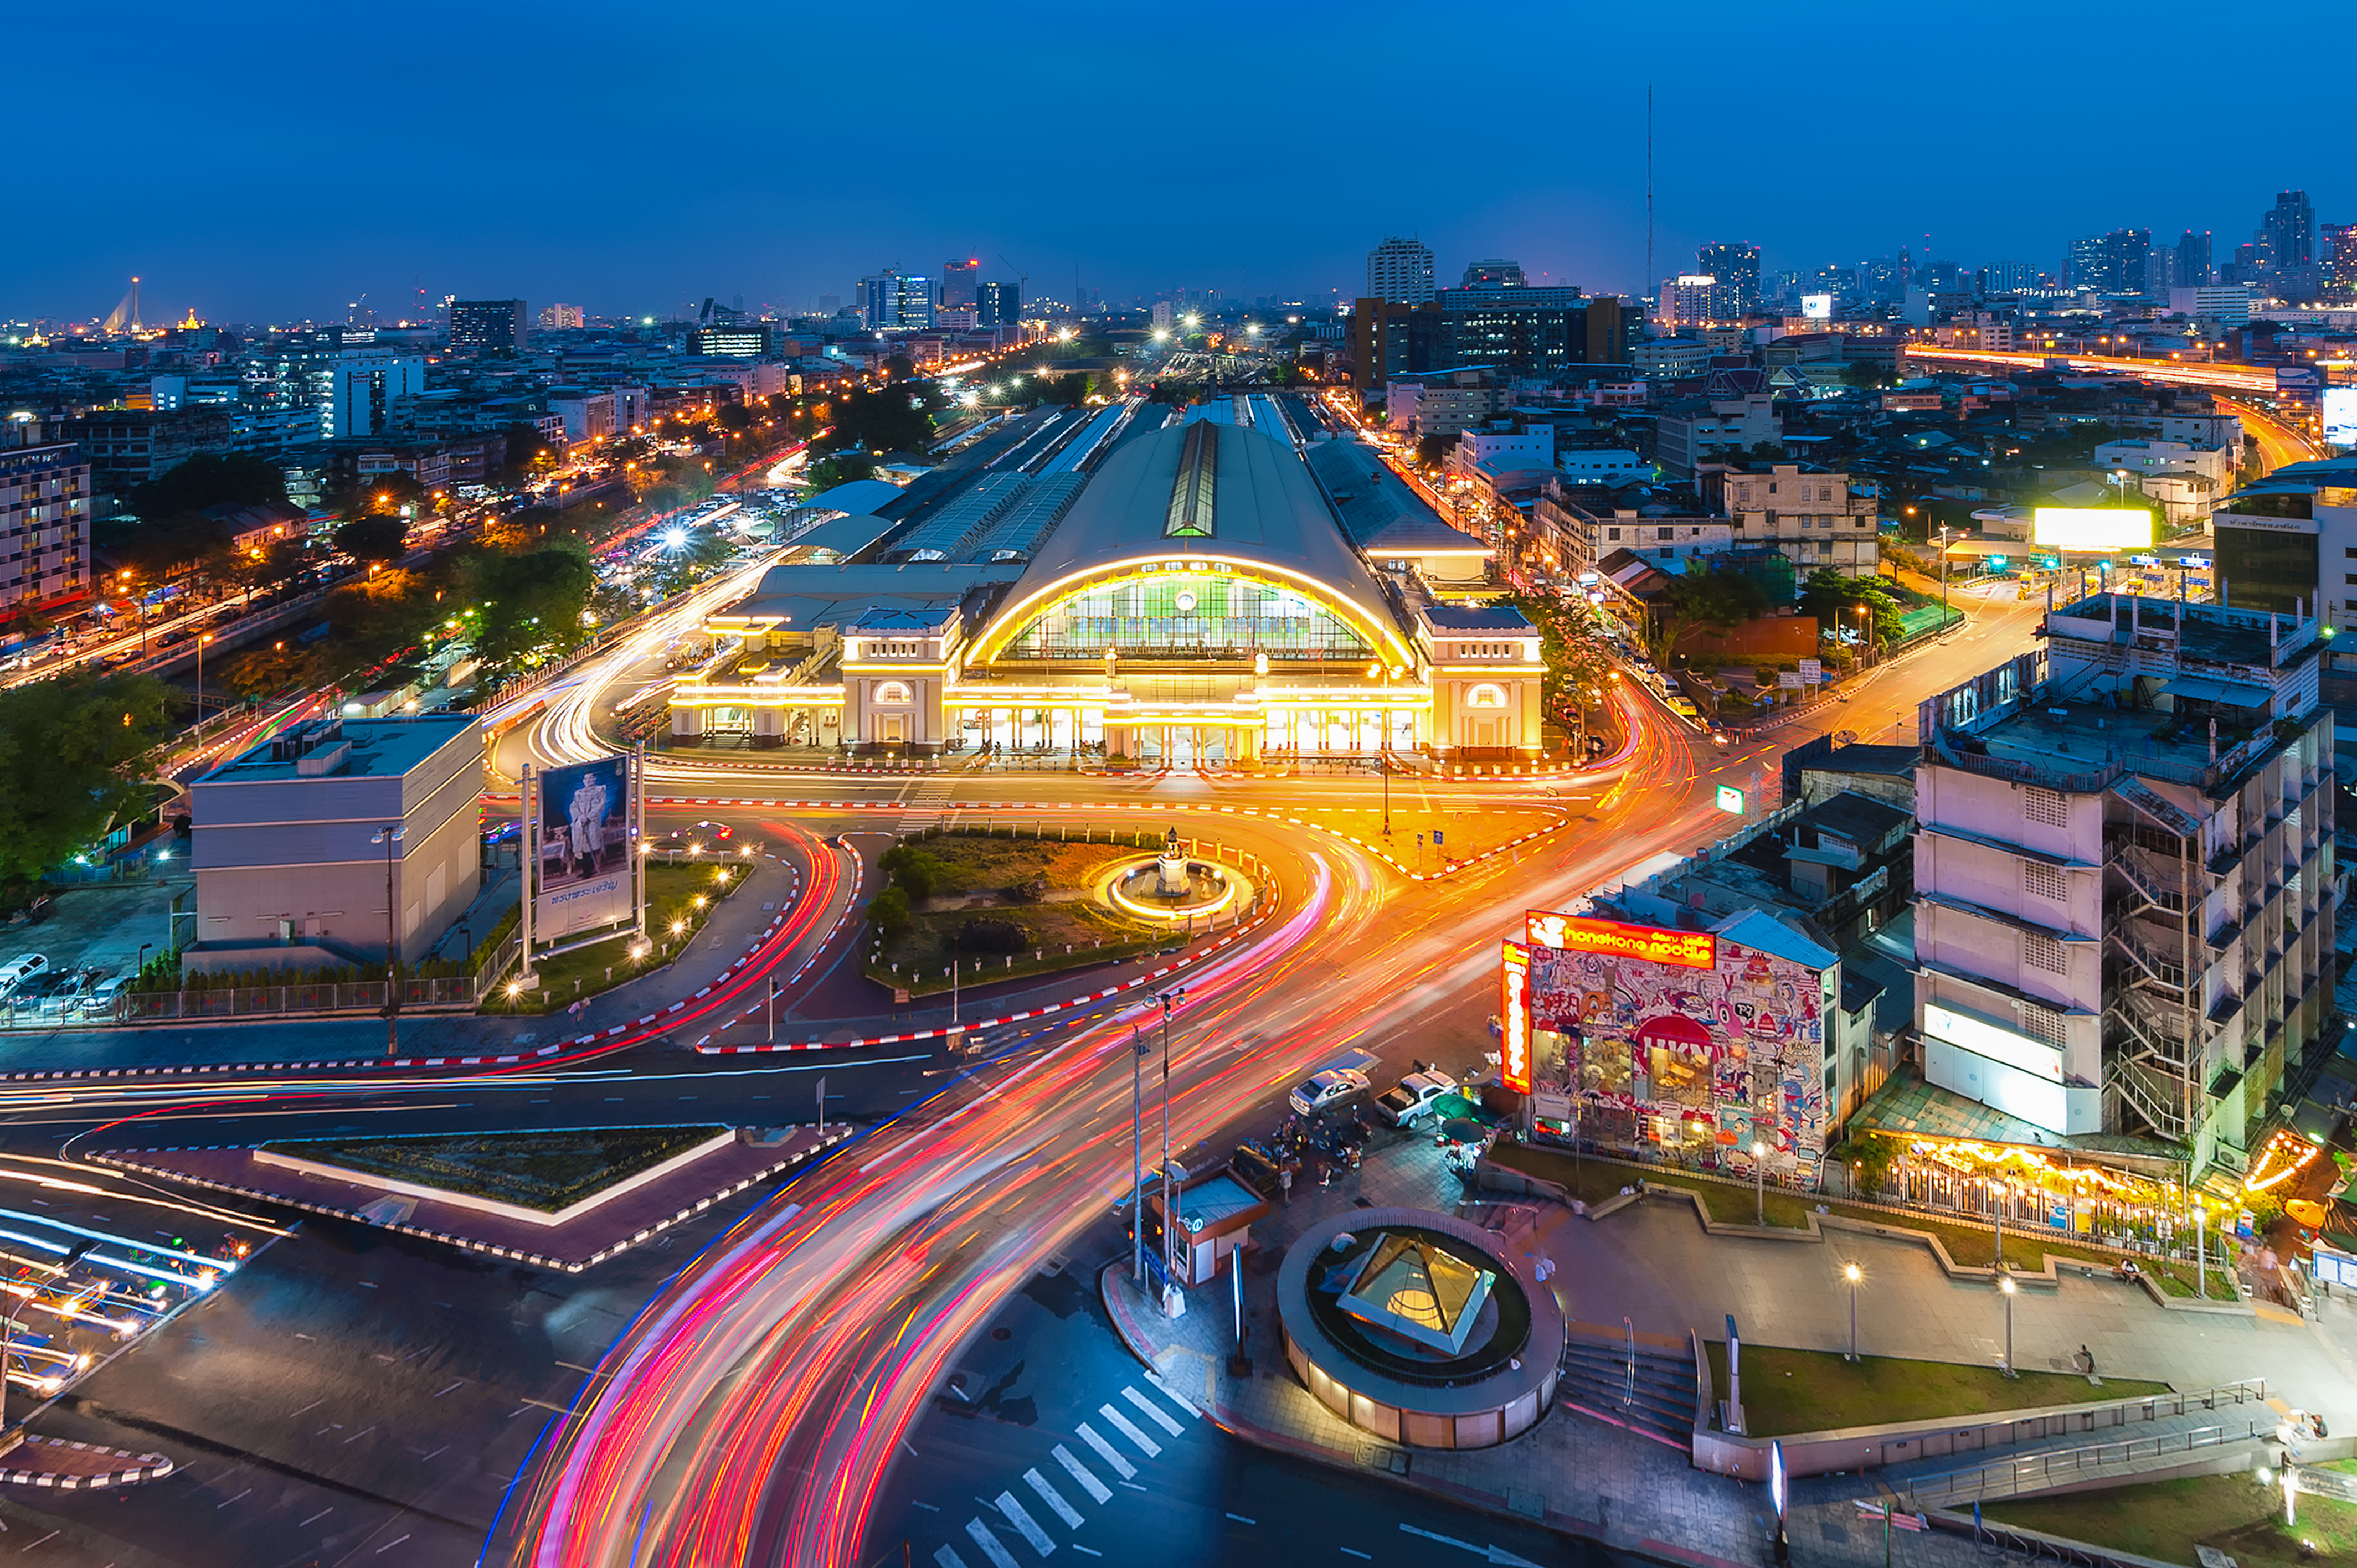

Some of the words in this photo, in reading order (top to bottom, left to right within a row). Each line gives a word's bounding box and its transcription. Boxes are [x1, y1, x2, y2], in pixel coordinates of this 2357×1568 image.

[551, 880, 619, 905] ทรงพระเจริญ
[1650, 942, 1711, 961] noodle
